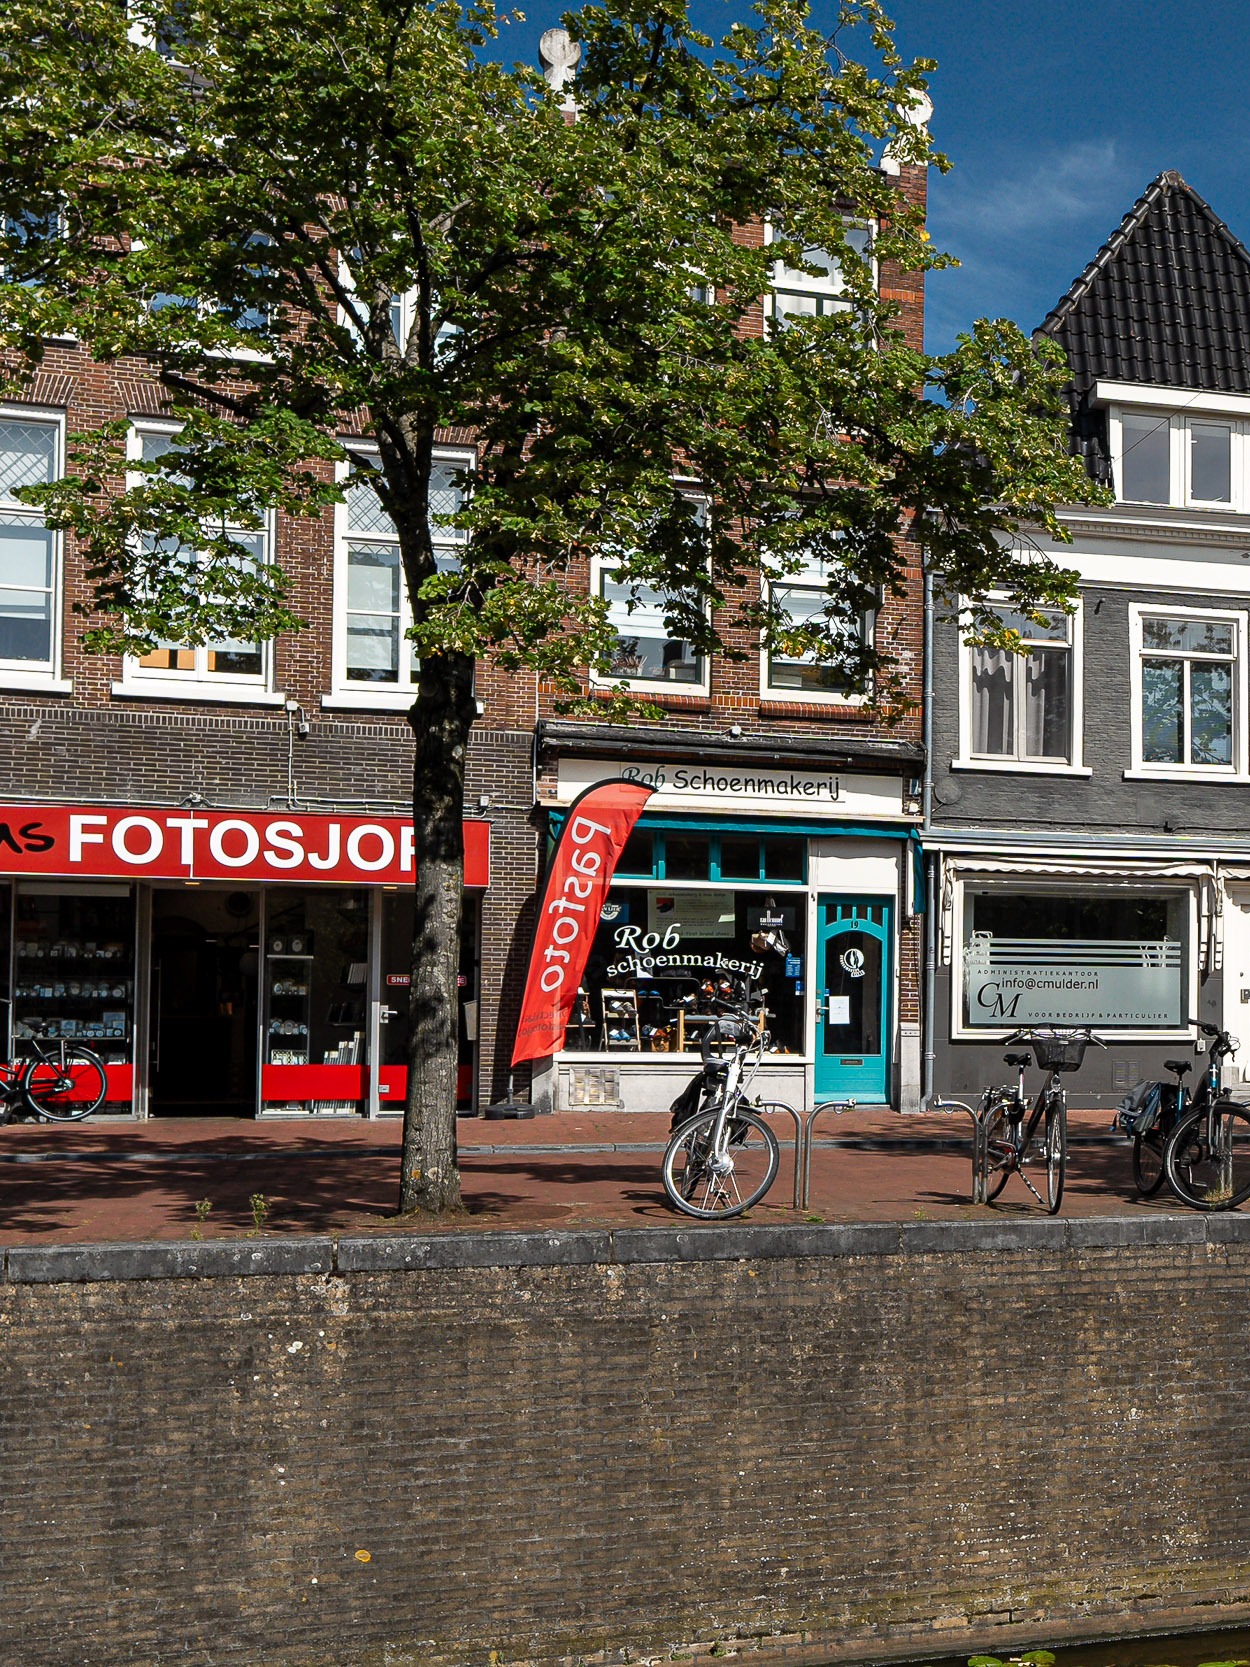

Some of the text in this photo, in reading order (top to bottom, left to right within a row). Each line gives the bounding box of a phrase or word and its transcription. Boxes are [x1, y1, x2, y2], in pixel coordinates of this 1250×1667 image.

[622, 765, 839, 800] Rob Schoenmakerij
[850, 920, 859, 929] 19
[614, 923, 681, 953] Rob
[607, 952, 764, 980] schoenmakerij
[977, 969, 1099, 977] ADMINISTRATIEKANTOOR
[1001, 977, 1099, 990] info@cmulder.nl
